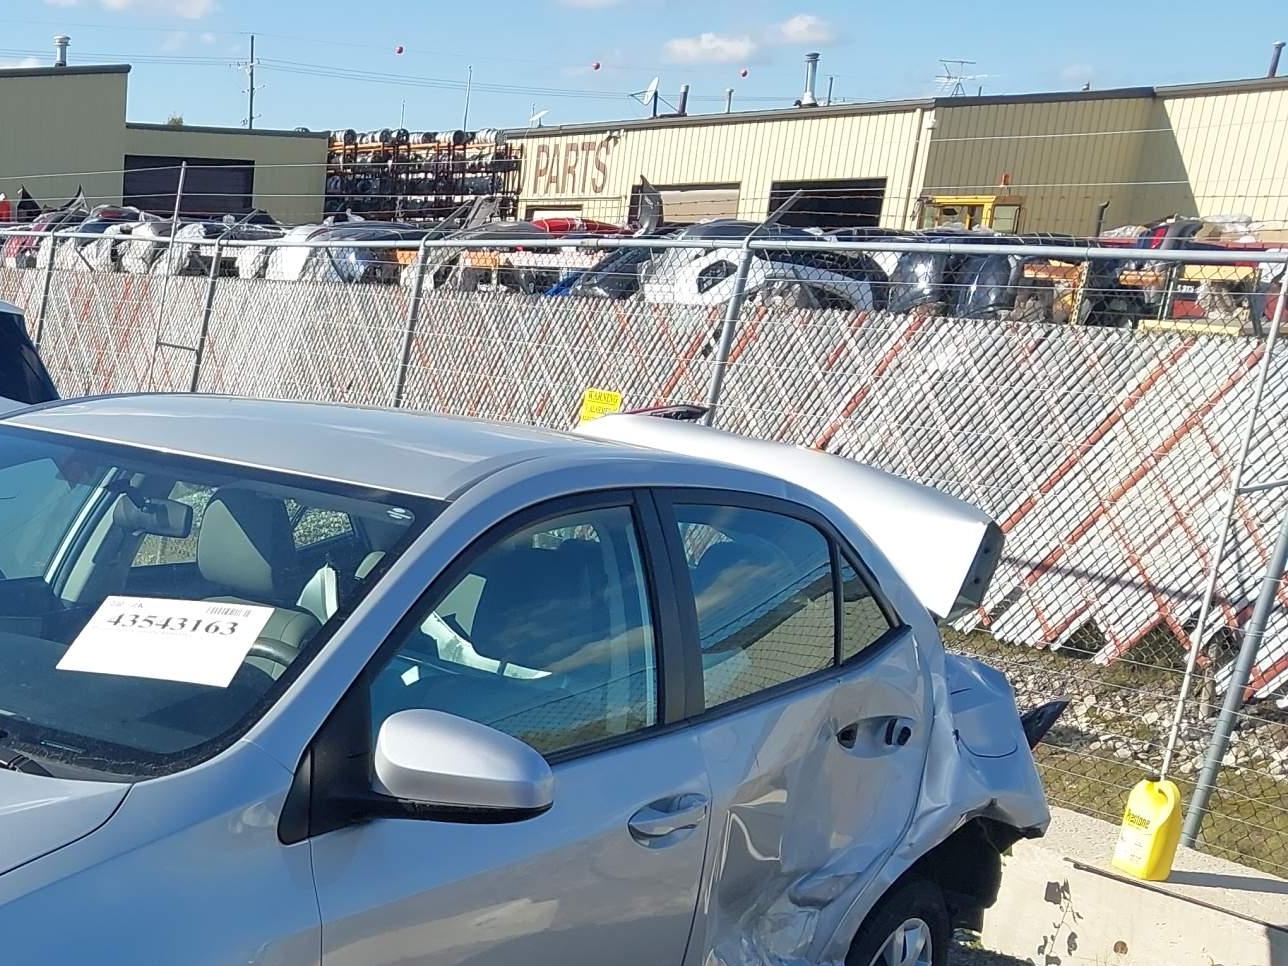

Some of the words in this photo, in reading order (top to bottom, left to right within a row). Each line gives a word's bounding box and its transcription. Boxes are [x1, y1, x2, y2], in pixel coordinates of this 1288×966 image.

[533, 141, 610, 194] PARTS
[588, 390, 619, 403] WARNING
[106, 612, 239, 636] 43543163
